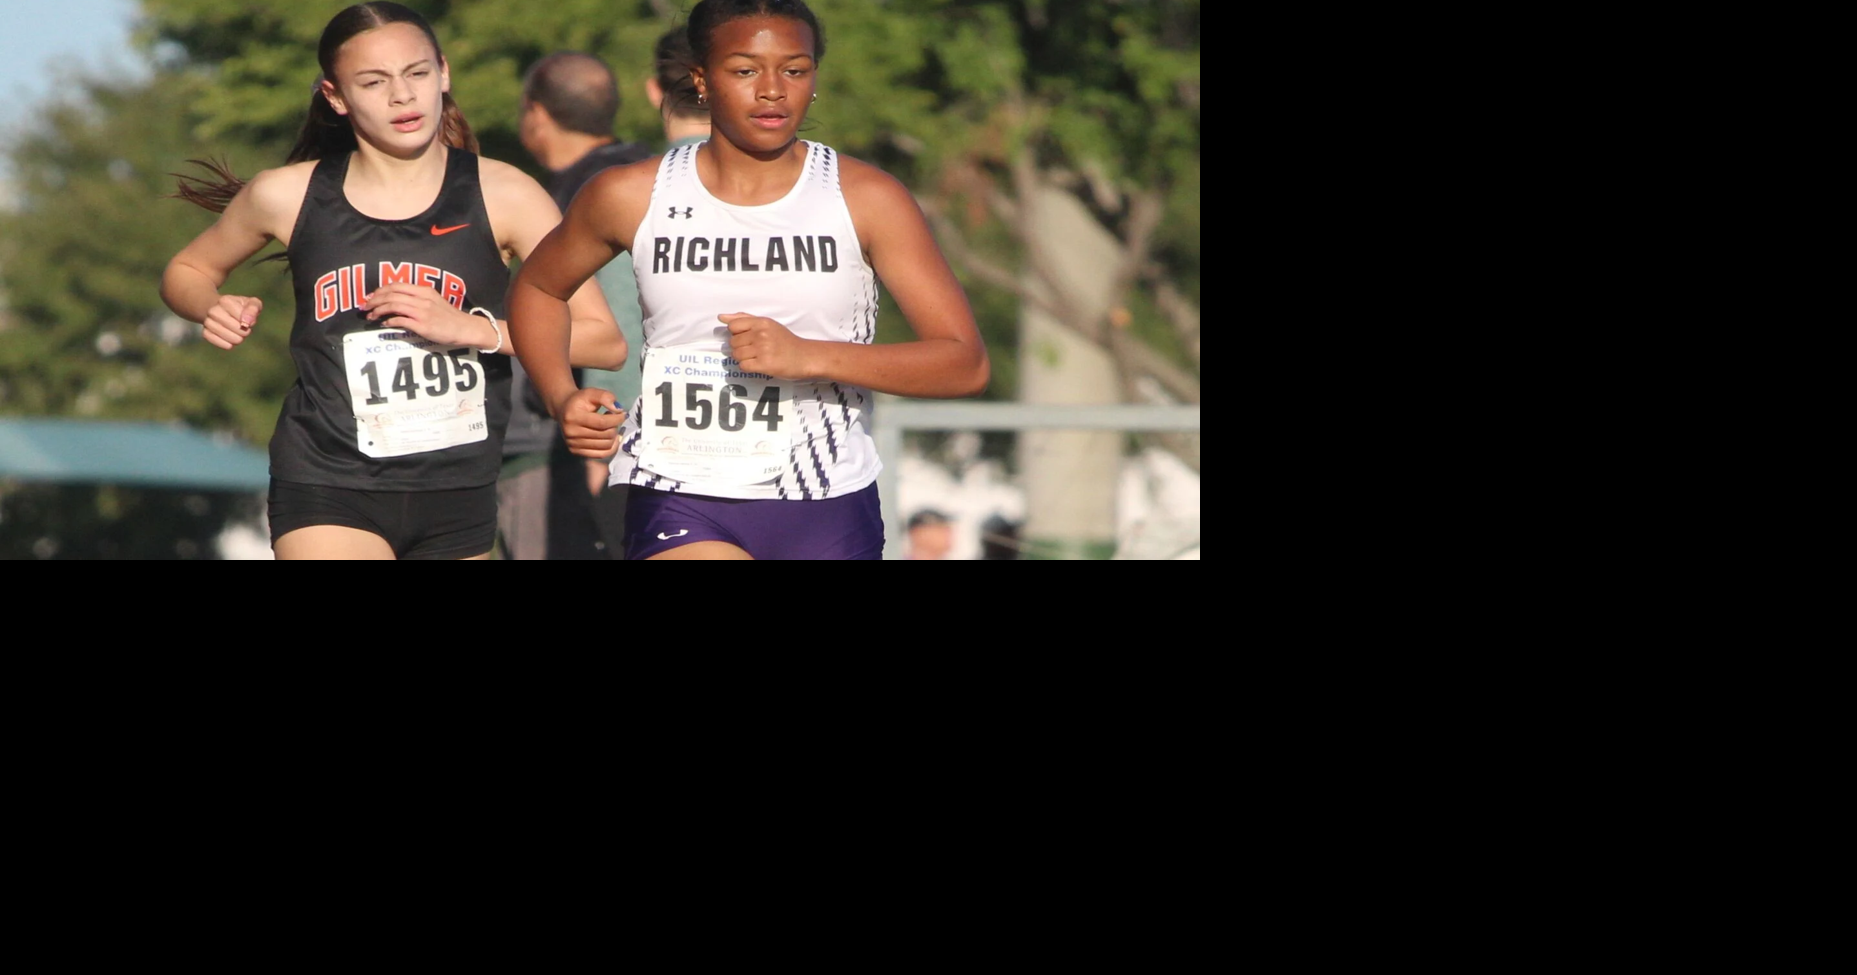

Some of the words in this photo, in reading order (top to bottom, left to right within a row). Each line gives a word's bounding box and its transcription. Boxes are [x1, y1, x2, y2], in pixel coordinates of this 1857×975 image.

[653, 236, 838, 274] RICHLAND
[314, 261, 466, 322] GILMER
[365, 345, 381, 354] XC
[679, 354, 699, 363] UIL
[704, 356, 740, 367] Regio
[664, 366, 681, 375] XC
[360, 348, 478, 405] 1495
[655, 381, 784, 432] 1564
[468, 422, 484, 431] 1495
[687, 444, 742, 454] ARLINGTON
[763, 466, 782, 474] 1564
